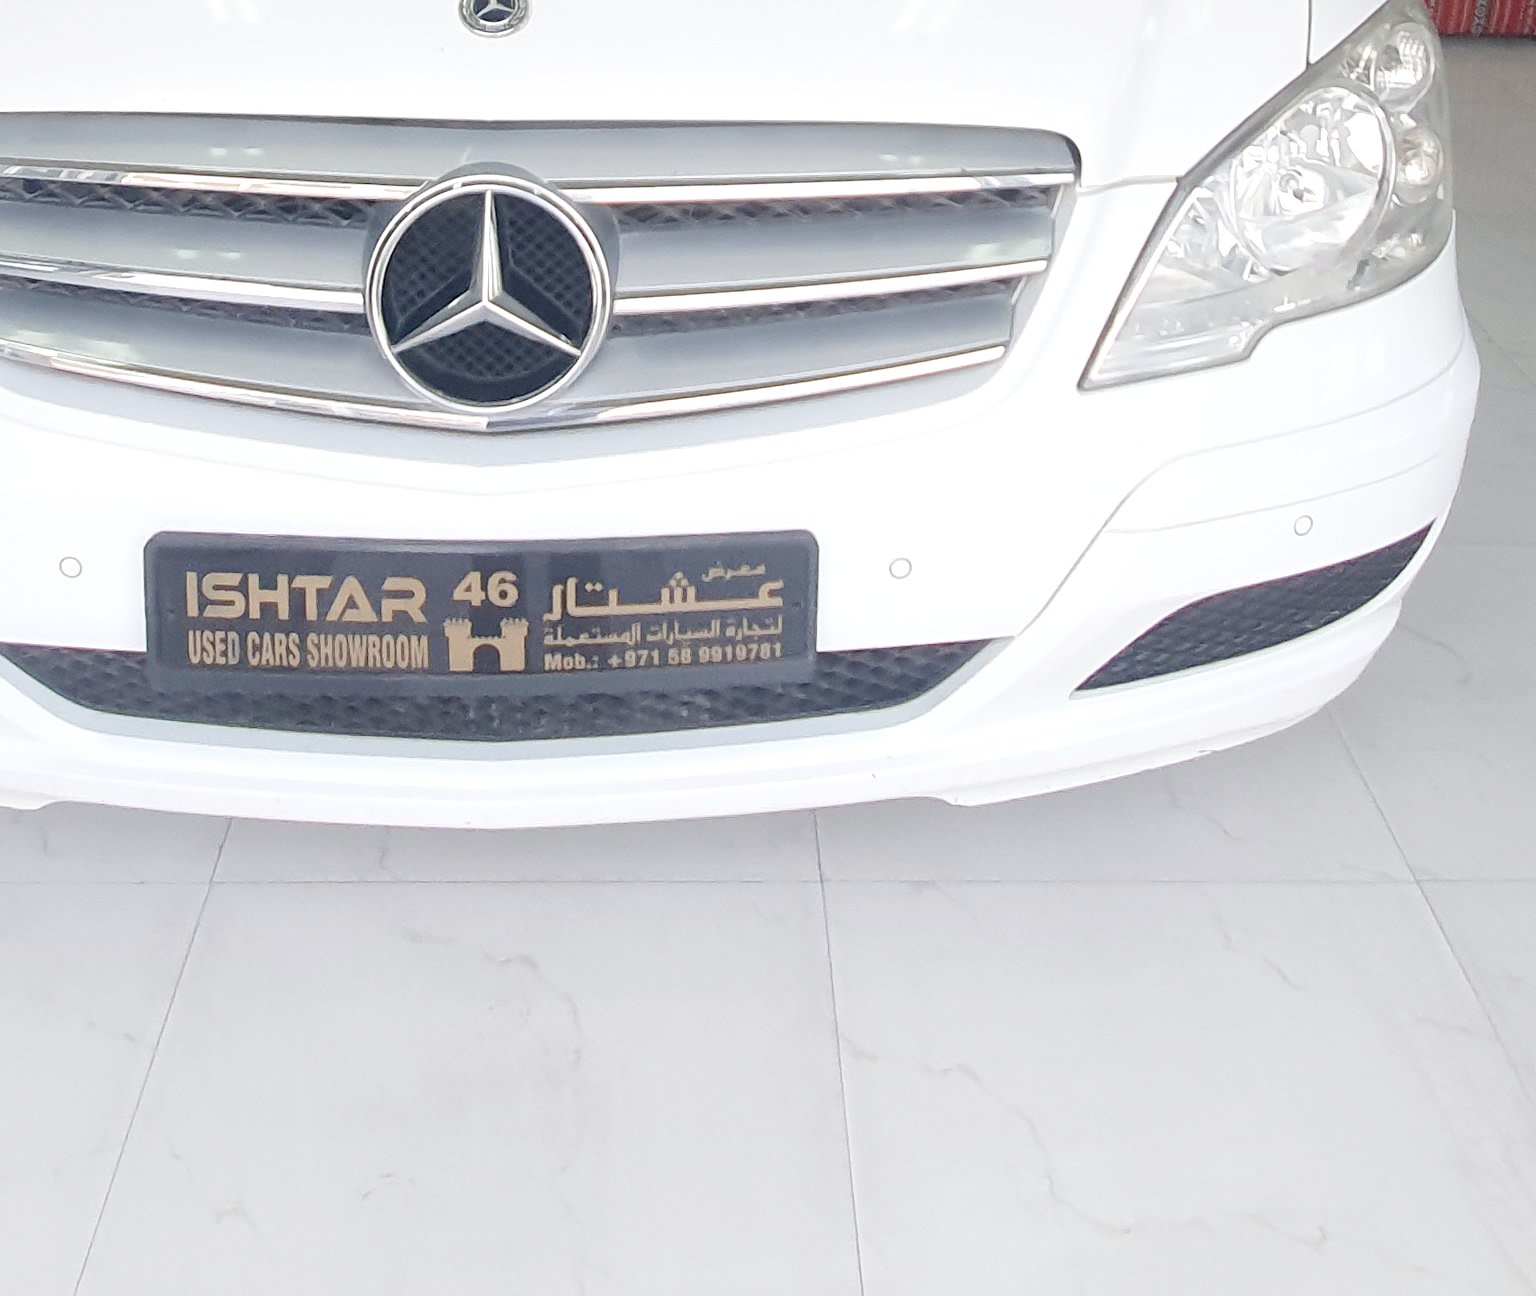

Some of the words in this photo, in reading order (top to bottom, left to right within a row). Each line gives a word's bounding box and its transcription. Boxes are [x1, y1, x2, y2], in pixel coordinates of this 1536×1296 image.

[186, 571, 427, 623] ISHTAR
[452, 571, 519, 608] 46
[543, 622, 641, 647] المستعملة
[646, 618, 721, 647] السيارات
[725, 614, 783, 641] لتجارة
[188, 629, 240, 666] USED
[245, 631, 300, 668] CARS
[306, 632, 429, 669] SHOWROOM
[608, 648, 660, 668] +971
